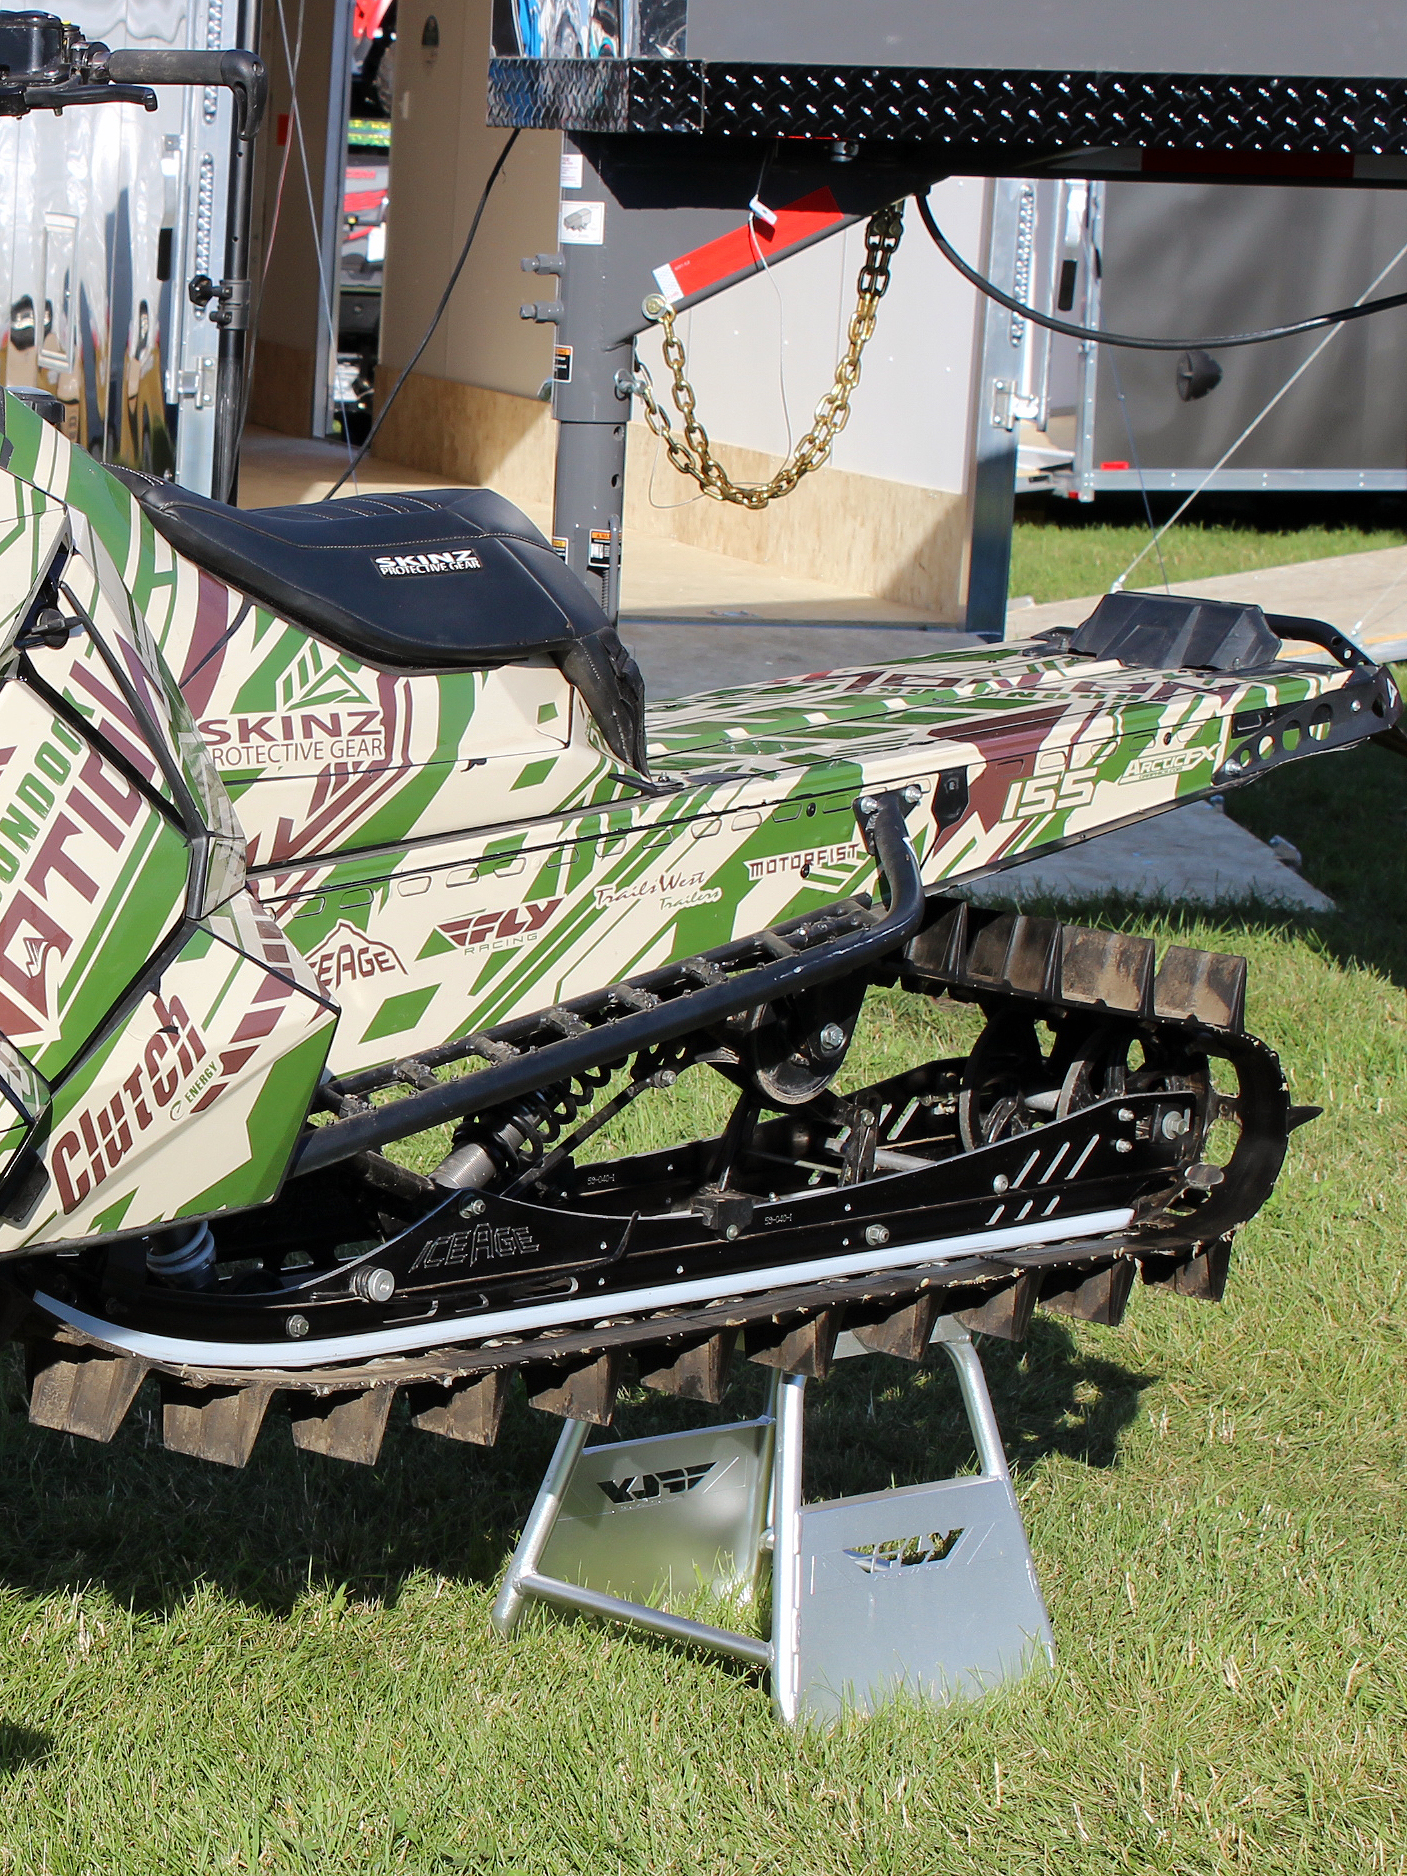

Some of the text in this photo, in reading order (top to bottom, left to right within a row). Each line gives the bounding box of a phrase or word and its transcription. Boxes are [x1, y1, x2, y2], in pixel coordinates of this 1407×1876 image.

[375, 549, 478, 568] SKINZ
[379, 559, 481, 576] PROTECTIVE GEAR
[197, 710, 382, 747] SKINZ
[330, 738, 383, 759] GEAR
[1000, 767, 1098, 822] 155
[748, 843, 861, 878] MOTORFIST
[659, 890, 720, 911] Trailers
[436, 896, 564, 947] FLY
[464, 932, 538, 956] RACING
[308, 943, 397, 992] EAGE
[184, 1061, 218, 1104] ENERGY
